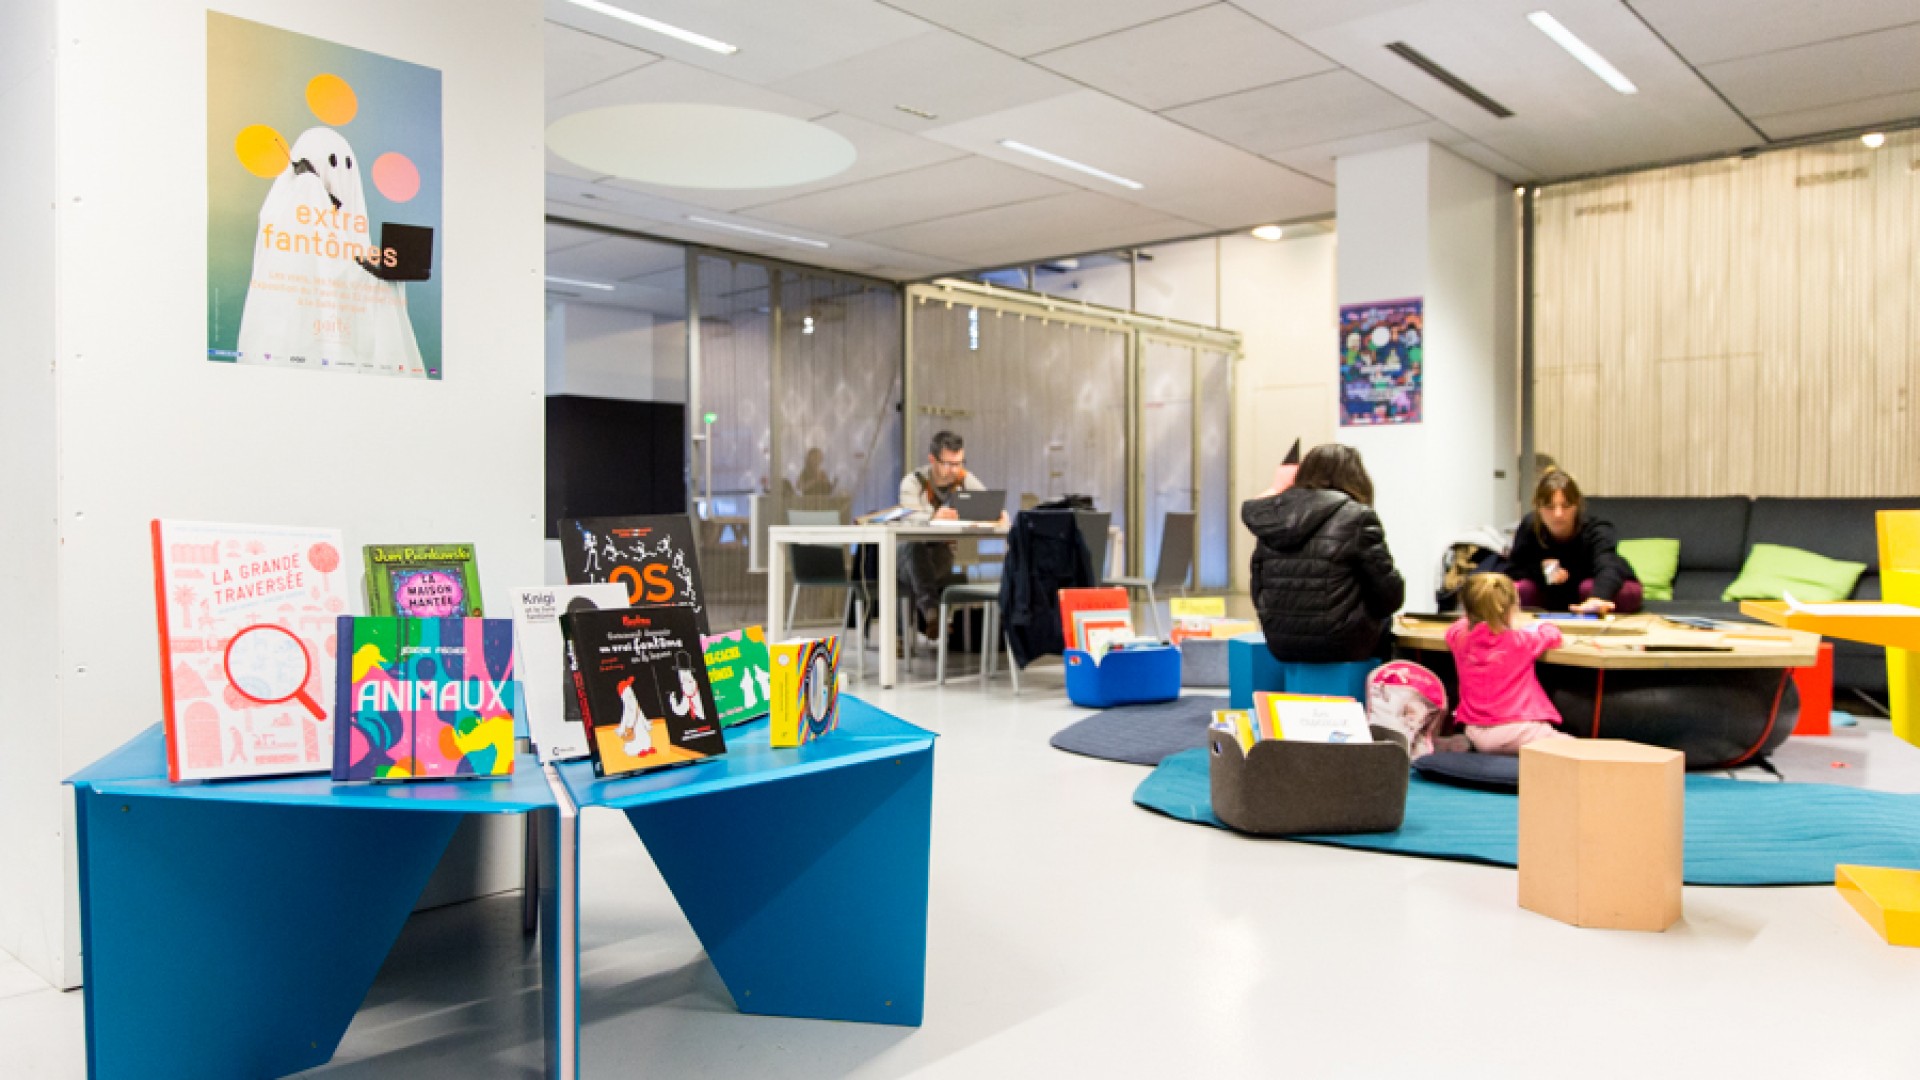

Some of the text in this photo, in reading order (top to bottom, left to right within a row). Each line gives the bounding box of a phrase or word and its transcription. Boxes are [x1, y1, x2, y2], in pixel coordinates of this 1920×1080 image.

[296, 204, 368, 234] extra
[263, 223, 398, 268] fantômes
[212, 552, 301, 586] LA GRANDE
[214, 568, 304, 605] TRAVERSÉE
[608, 562, 675, 606] OS
[357, 680, 507, 712] ANIMAUX
